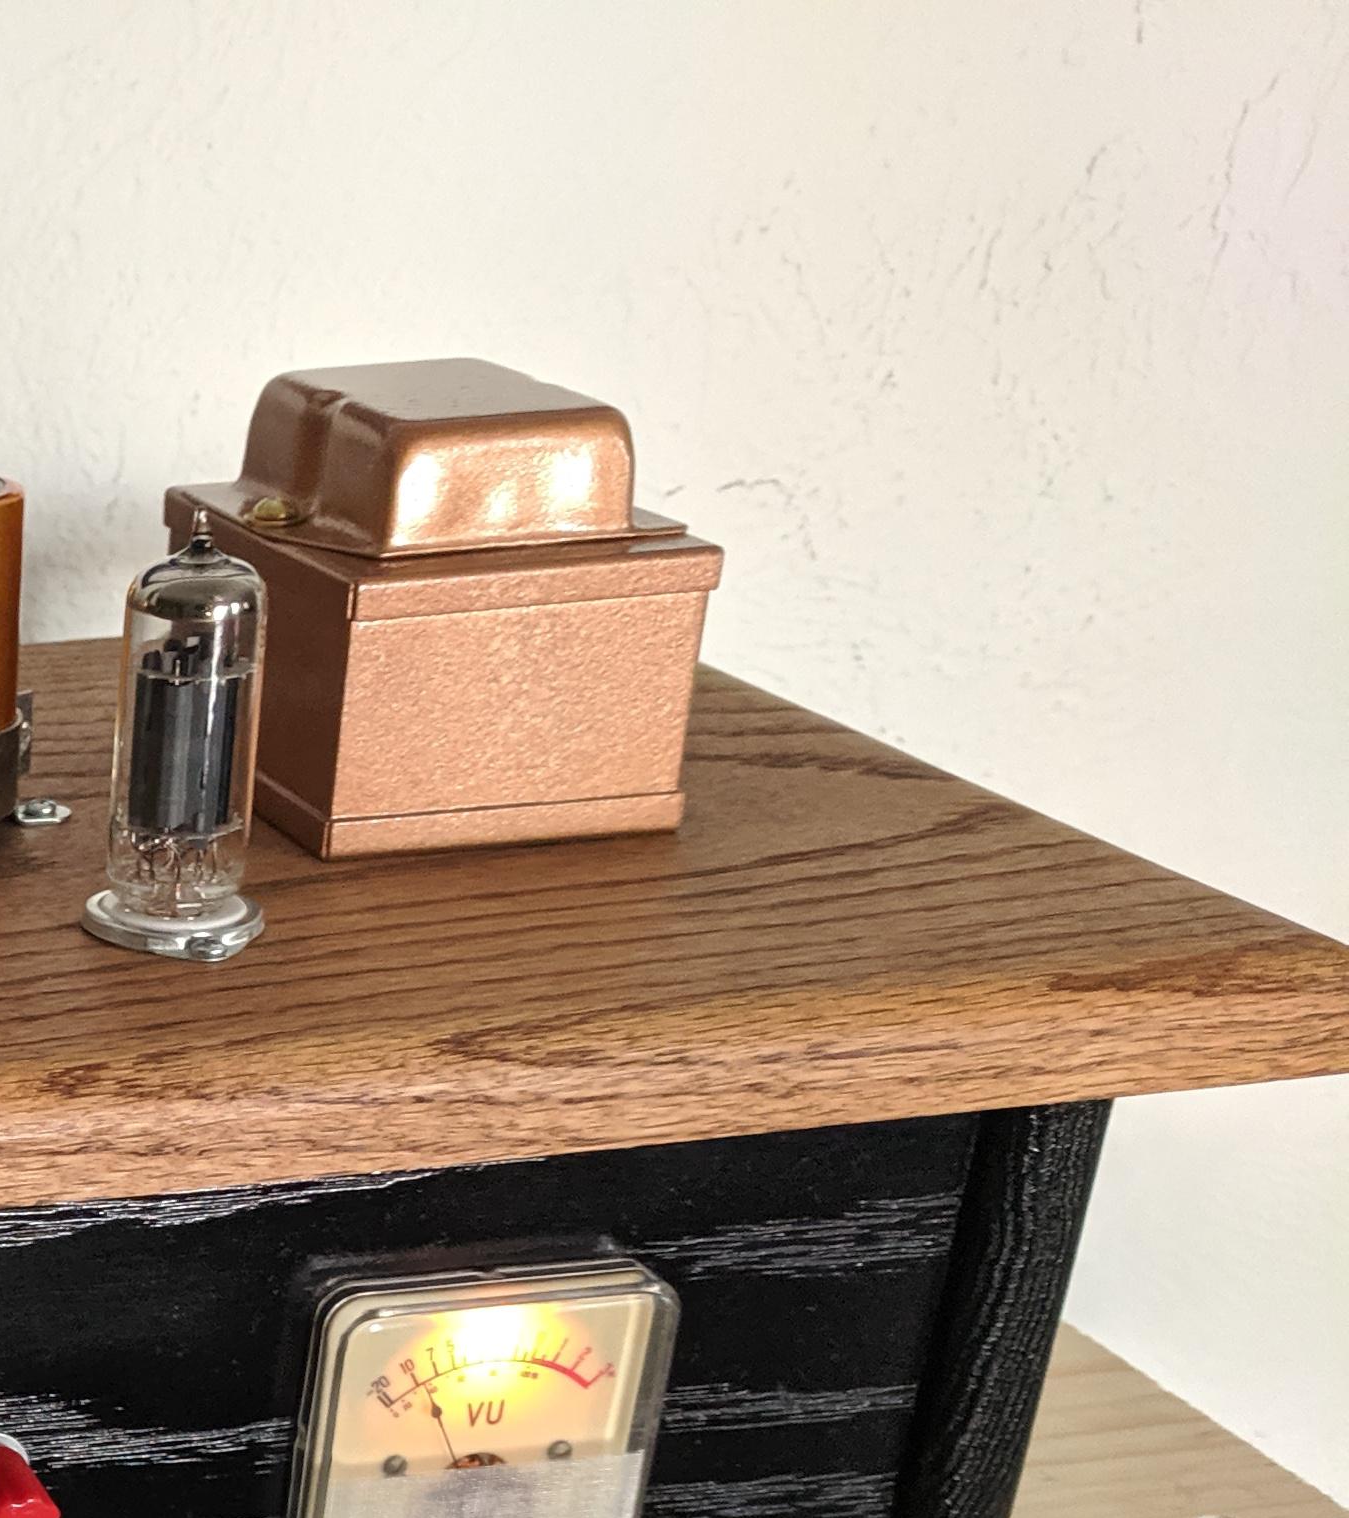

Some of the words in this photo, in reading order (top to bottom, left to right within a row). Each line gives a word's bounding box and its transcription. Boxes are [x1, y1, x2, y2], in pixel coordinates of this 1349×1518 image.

[399, 1358, 415, 1374] 10
[425, 1346, 434, 1361] 7
[467, 1399, 506, 1427] VU
